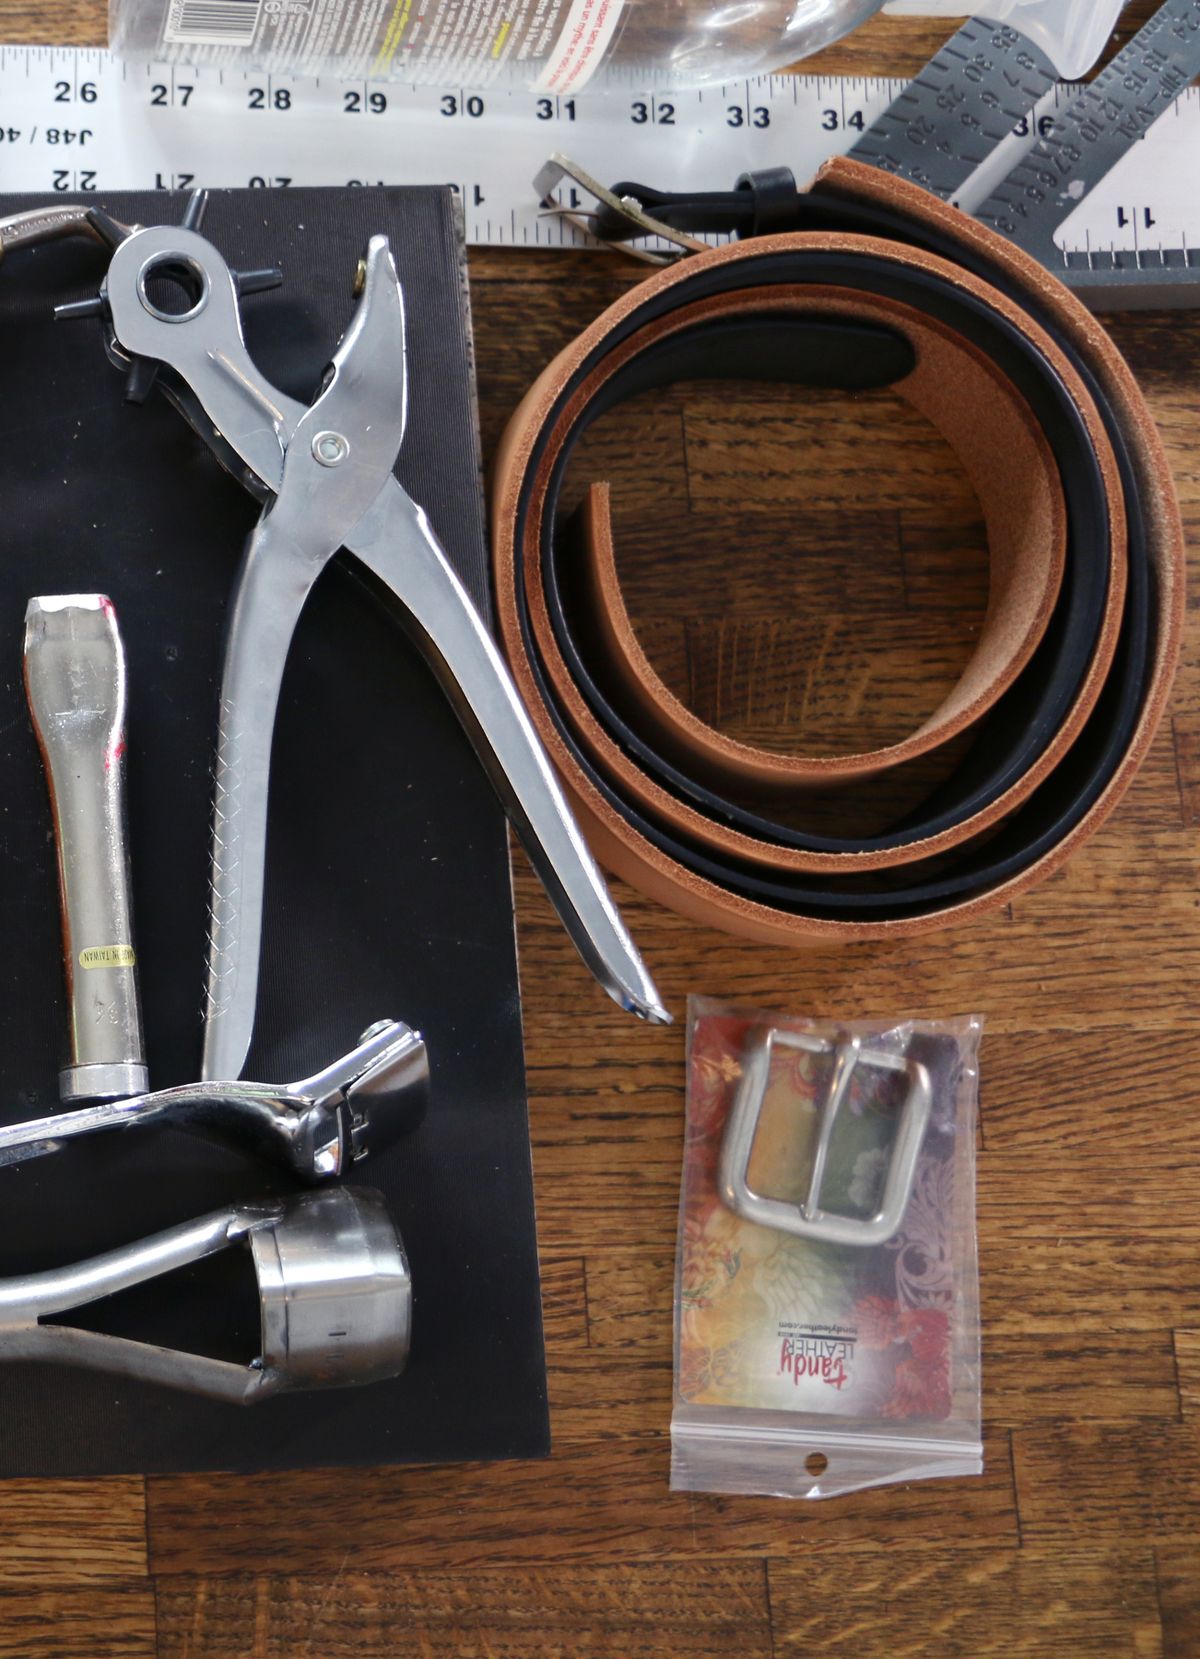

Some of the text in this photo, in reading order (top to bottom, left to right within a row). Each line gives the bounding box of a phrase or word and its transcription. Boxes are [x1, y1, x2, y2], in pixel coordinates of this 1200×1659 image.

[963, 53, 994, 83] 30
[1015, 52, 1036, 70] 8
[1003, 70, 1020, 88] 7
[54, 81, 97, 103] 26
[151, 84, 194, 106] 27
[248, 88, 291, 110] 28
[344, 92, 387, 114] 29
[441, 95, 484, 117] 30
[537, 98, 576, 121] 31
[631, 102, 675, 125] 32
[727, 106, 770, 128] 33
[822, 109, 865, 131] 34
[936, 84, 966, 113] 25
[980, 91, 1000, 109] 6
[46, 127, 94, 145] J48
[905, 116, 935, 145] 20
[1080, 117, 1104, 142] 10
[52, 169, 96, 191] 22
[787, 1339, 855, 1361] LEATHER
[779, 1338, 848, 1391] tandy
